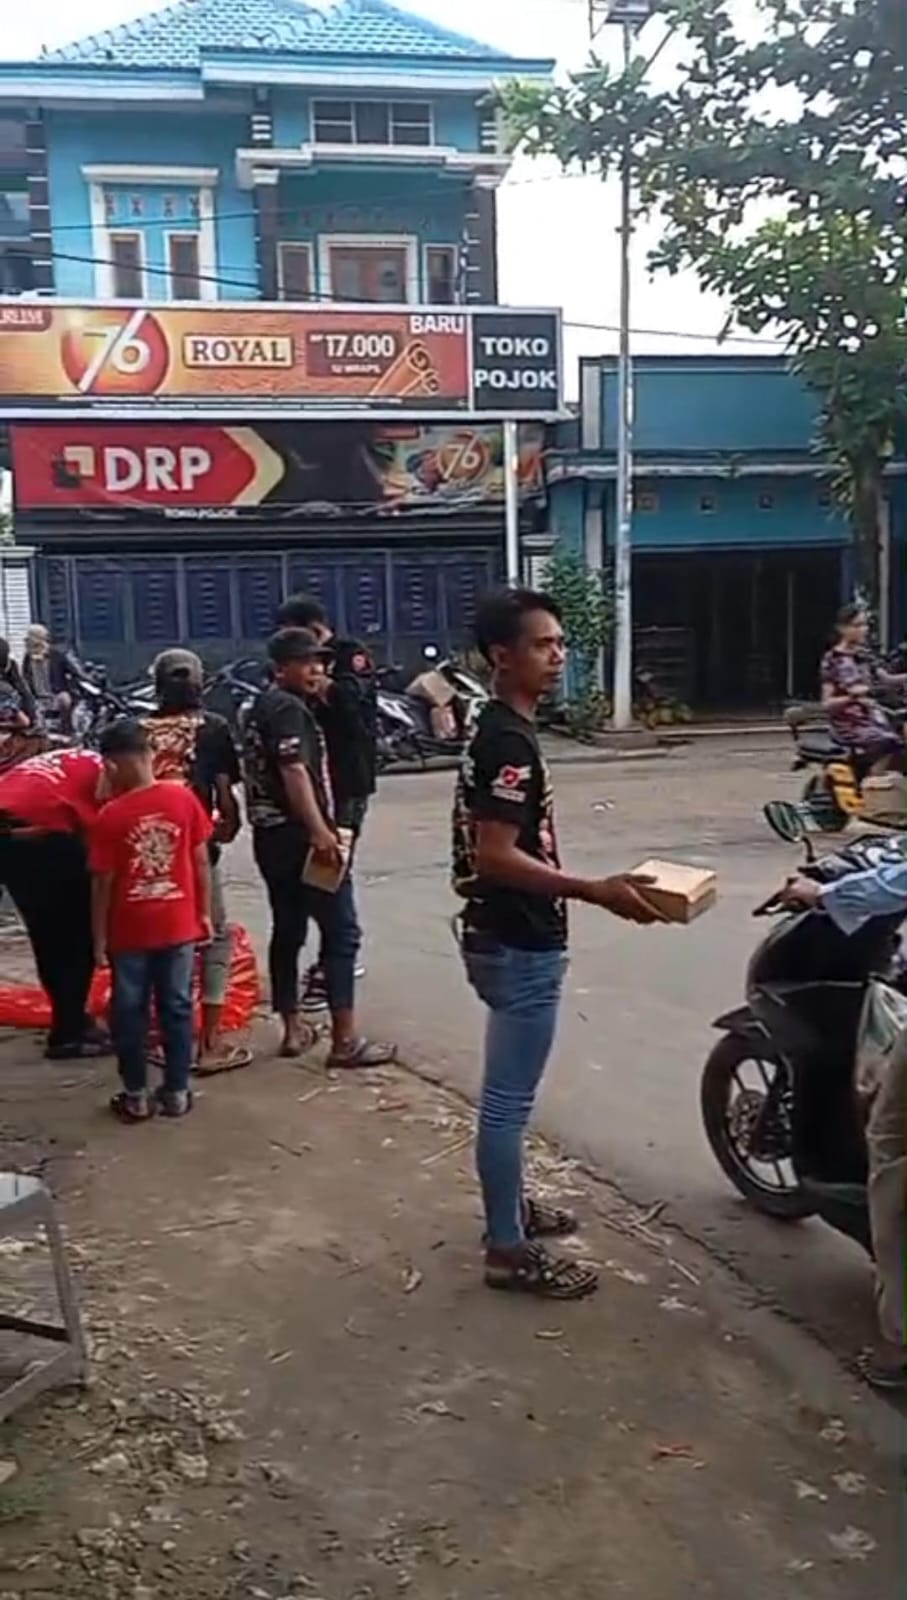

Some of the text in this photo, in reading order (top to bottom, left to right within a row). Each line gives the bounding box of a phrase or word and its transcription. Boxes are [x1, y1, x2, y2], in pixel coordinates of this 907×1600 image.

[410, 314, 464, 335] BARU
[79, 310, 151, 392] 76
[191, 340, 287, 362] ROYAL
[480, 336, 549, 356] TOKO
[475, 369, 557, 389] POJOK
[103, 447, 212, 492] DRP
